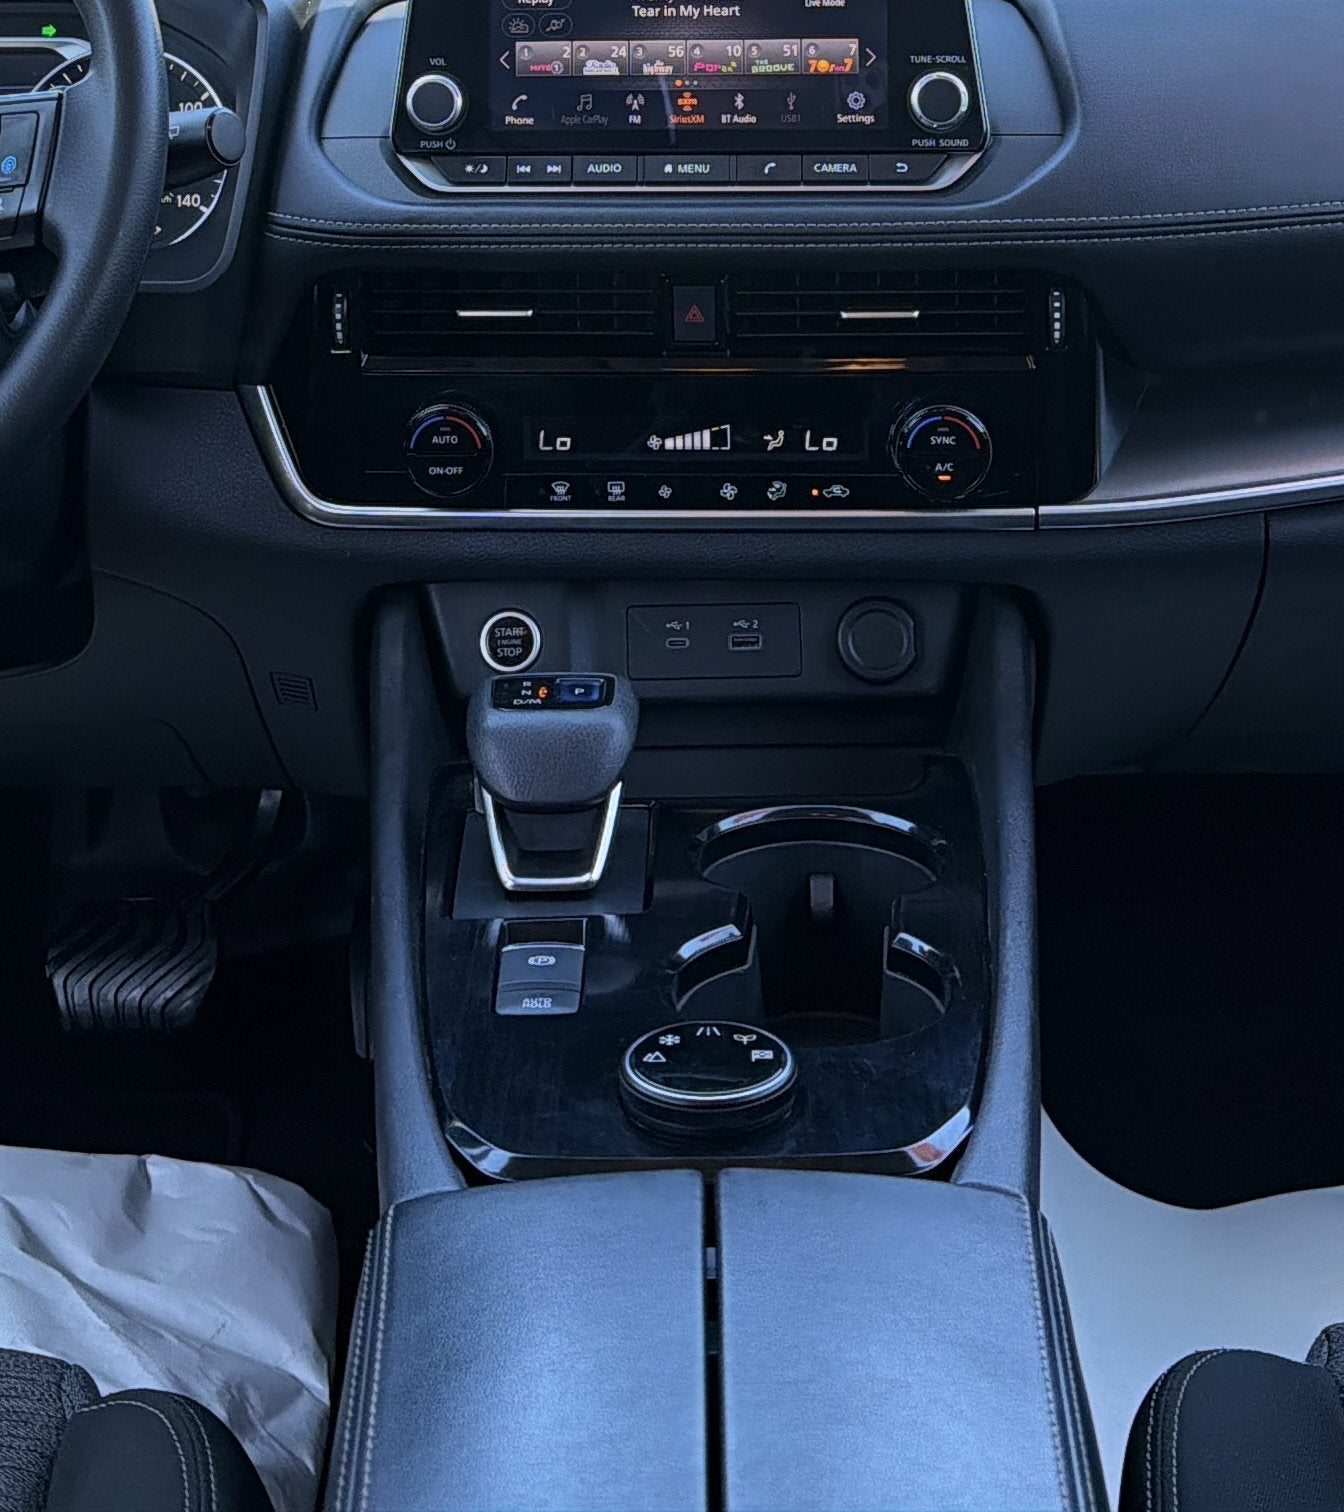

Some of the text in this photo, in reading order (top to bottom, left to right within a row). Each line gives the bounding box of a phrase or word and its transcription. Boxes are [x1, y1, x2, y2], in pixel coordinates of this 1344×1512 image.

[632, 5, 741, 20] Tear in My Heart
[561, 46, 571, 59] 2
[610, 45, 627, 59] 24
[667, 44, 685, 58] 56
[725, 44, 743, 57] 10
[782, 45, 799, 57] 51
[848, 43, 857, 56] 7
[428, 57, 447, 66] VOL
[751, 62, 795, 74] GROOVE
[504, 115, 535, 126] Phone
[560, 114, 609, 126] Apple CarPlay
[628, 115, 641, 125] FM
[669, 114, 705, 125] SiriusXM
[721, 114, 757, 124] BT Audio
[780, 114, 801, 124] USB1
[836, 113, 876, 125] Settings
[419, 139, 444, 149] PUSH
[911, 138, 970, 148] PUSH SOUND
[586, 163, 623, 174] AUDIO
[677, 163, 711, 174] MENU
[813, 163, 859, 173] CAMERA
[176, 193, 201, 209] 140
[431, 435, 459, 445] AUTO
[539, 429, 572, 451] Lo
[804, 429, 839, 452] Lo
[930, 436, 957, 446] SYNC
[934, 462, 955, 472] A/C
[752, 619, 759, 629] 2
[494, 626, 526, 638] START
[497, 638, 523, 646] ENGINE
[496, 647, 523, 658] STOP
[574, 687, 585, 695] P
[512, 698, 543, 706] D/M
